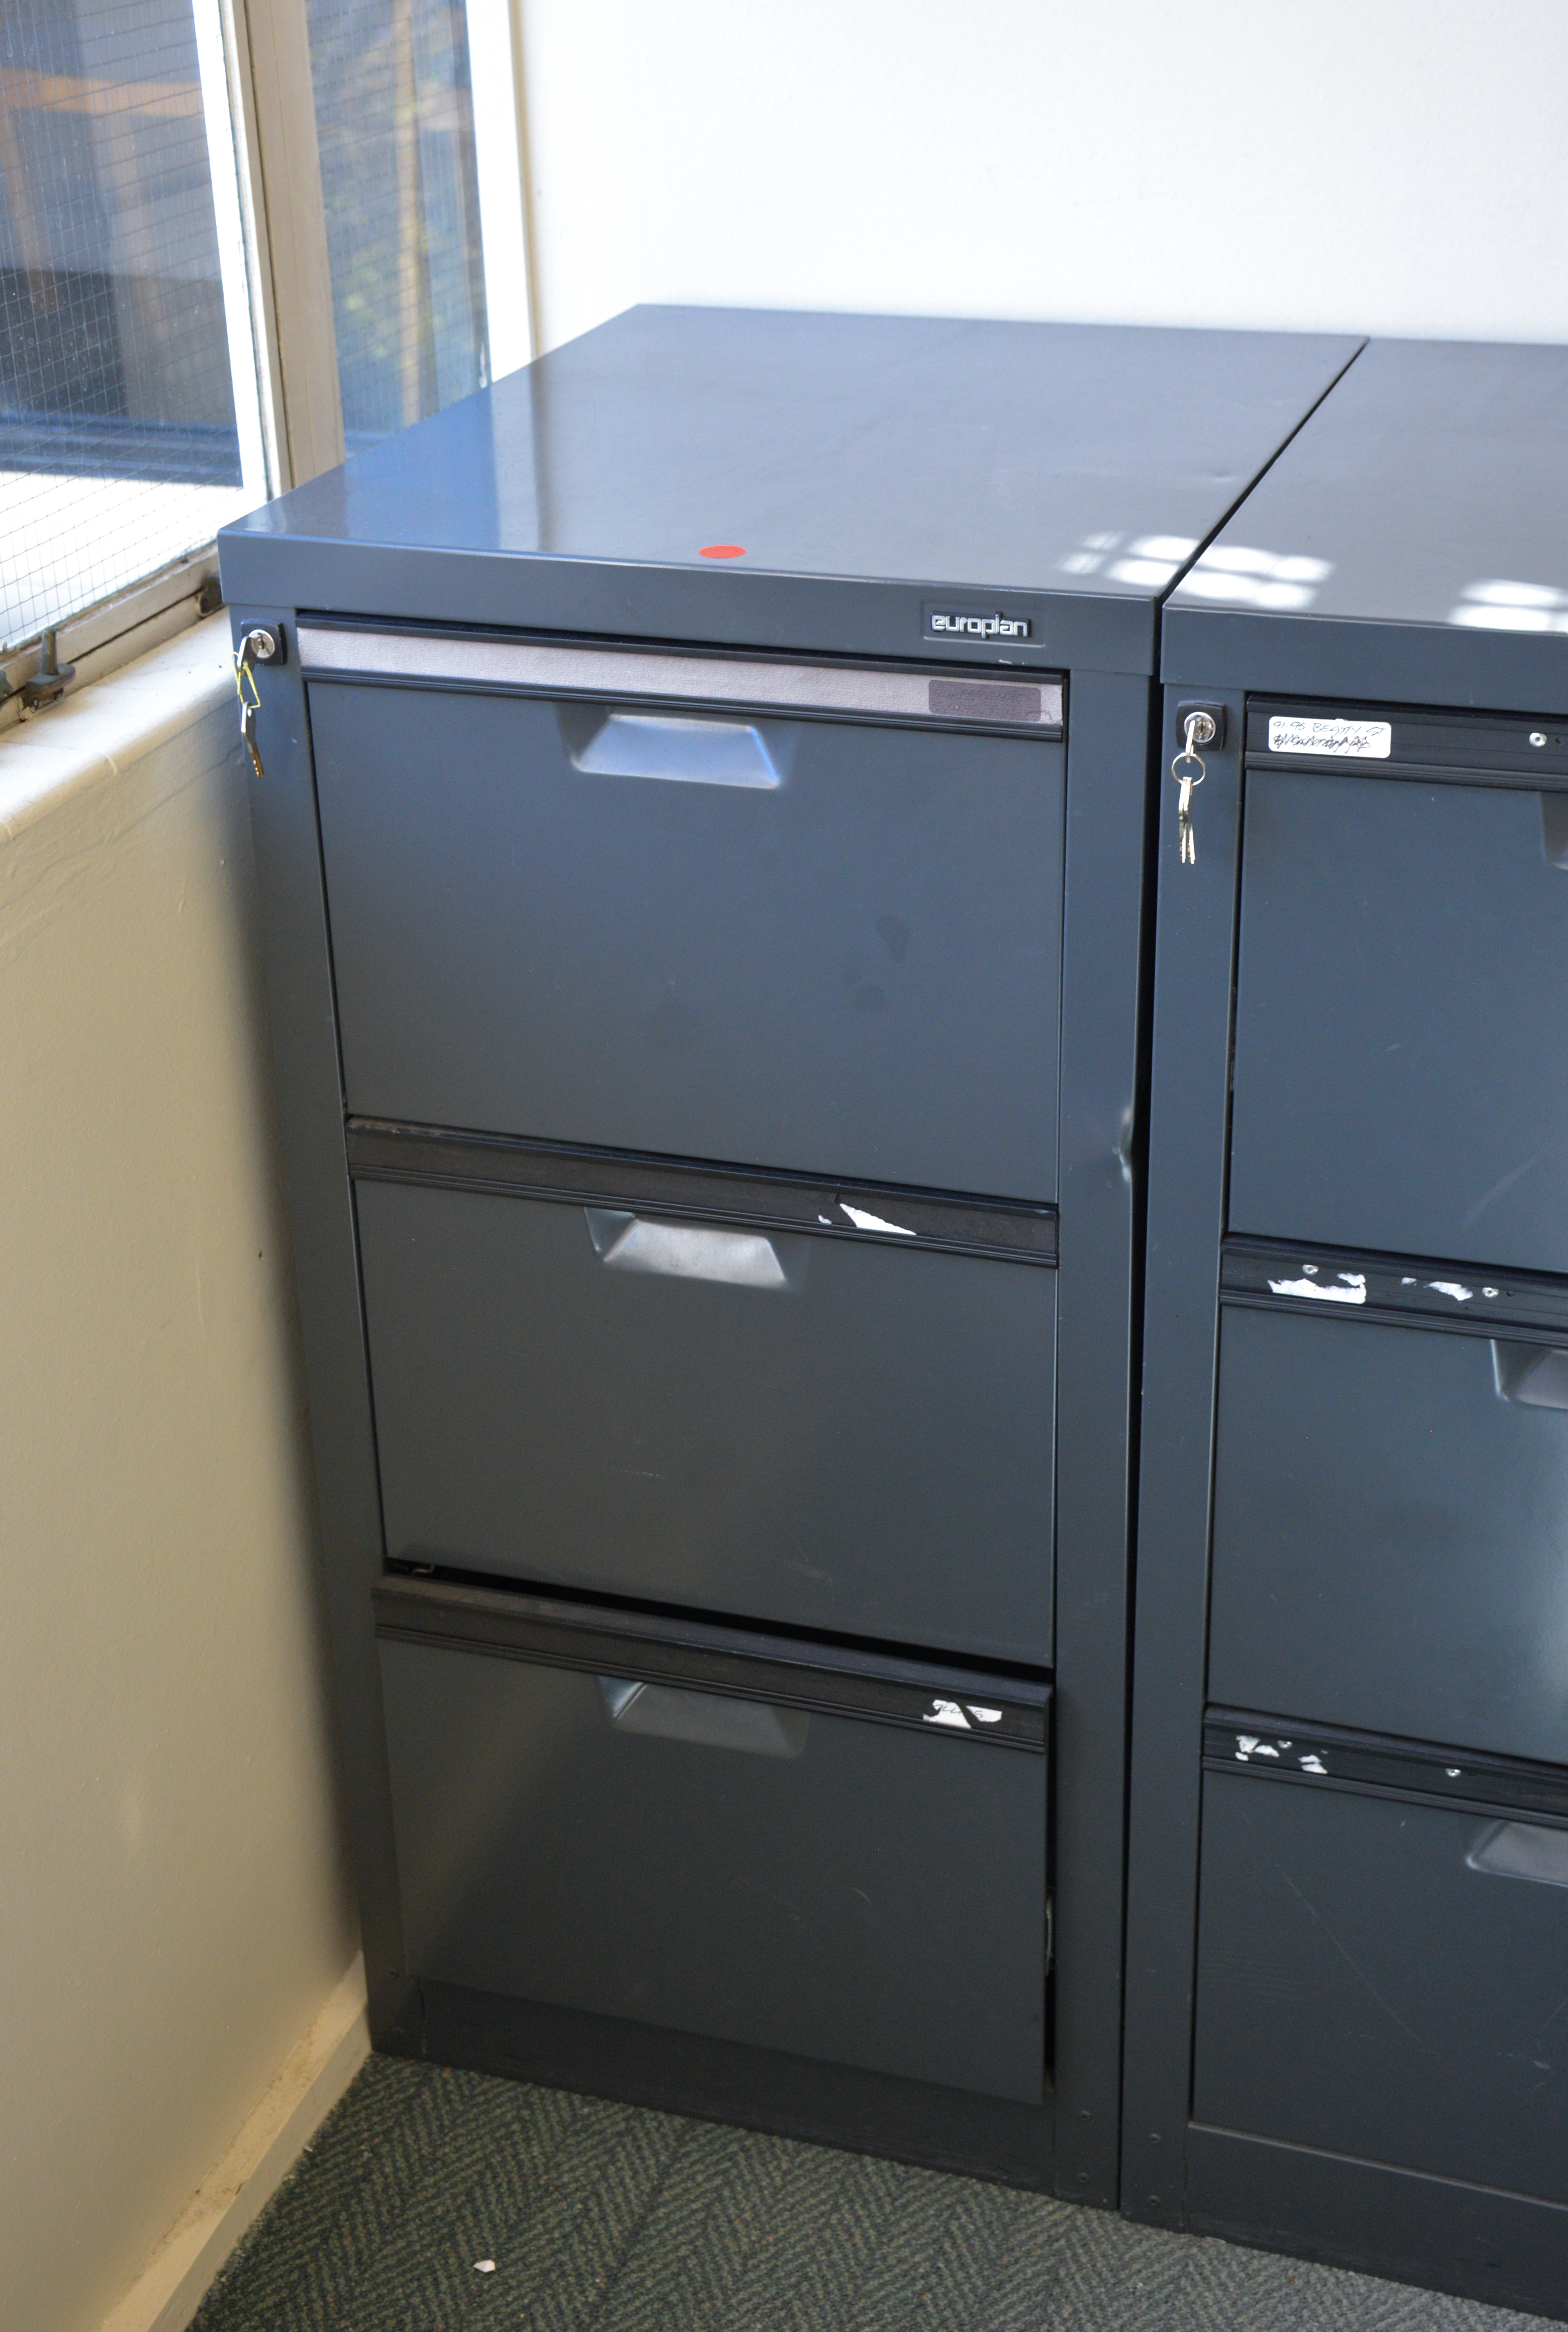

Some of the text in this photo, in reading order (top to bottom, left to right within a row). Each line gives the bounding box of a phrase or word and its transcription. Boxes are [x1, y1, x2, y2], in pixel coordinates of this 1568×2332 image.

[931, 613, 1029, 639] europlan
[1312, 723, 1362, 736] BEATTY
[1366, 726, 1387, 736] ST
